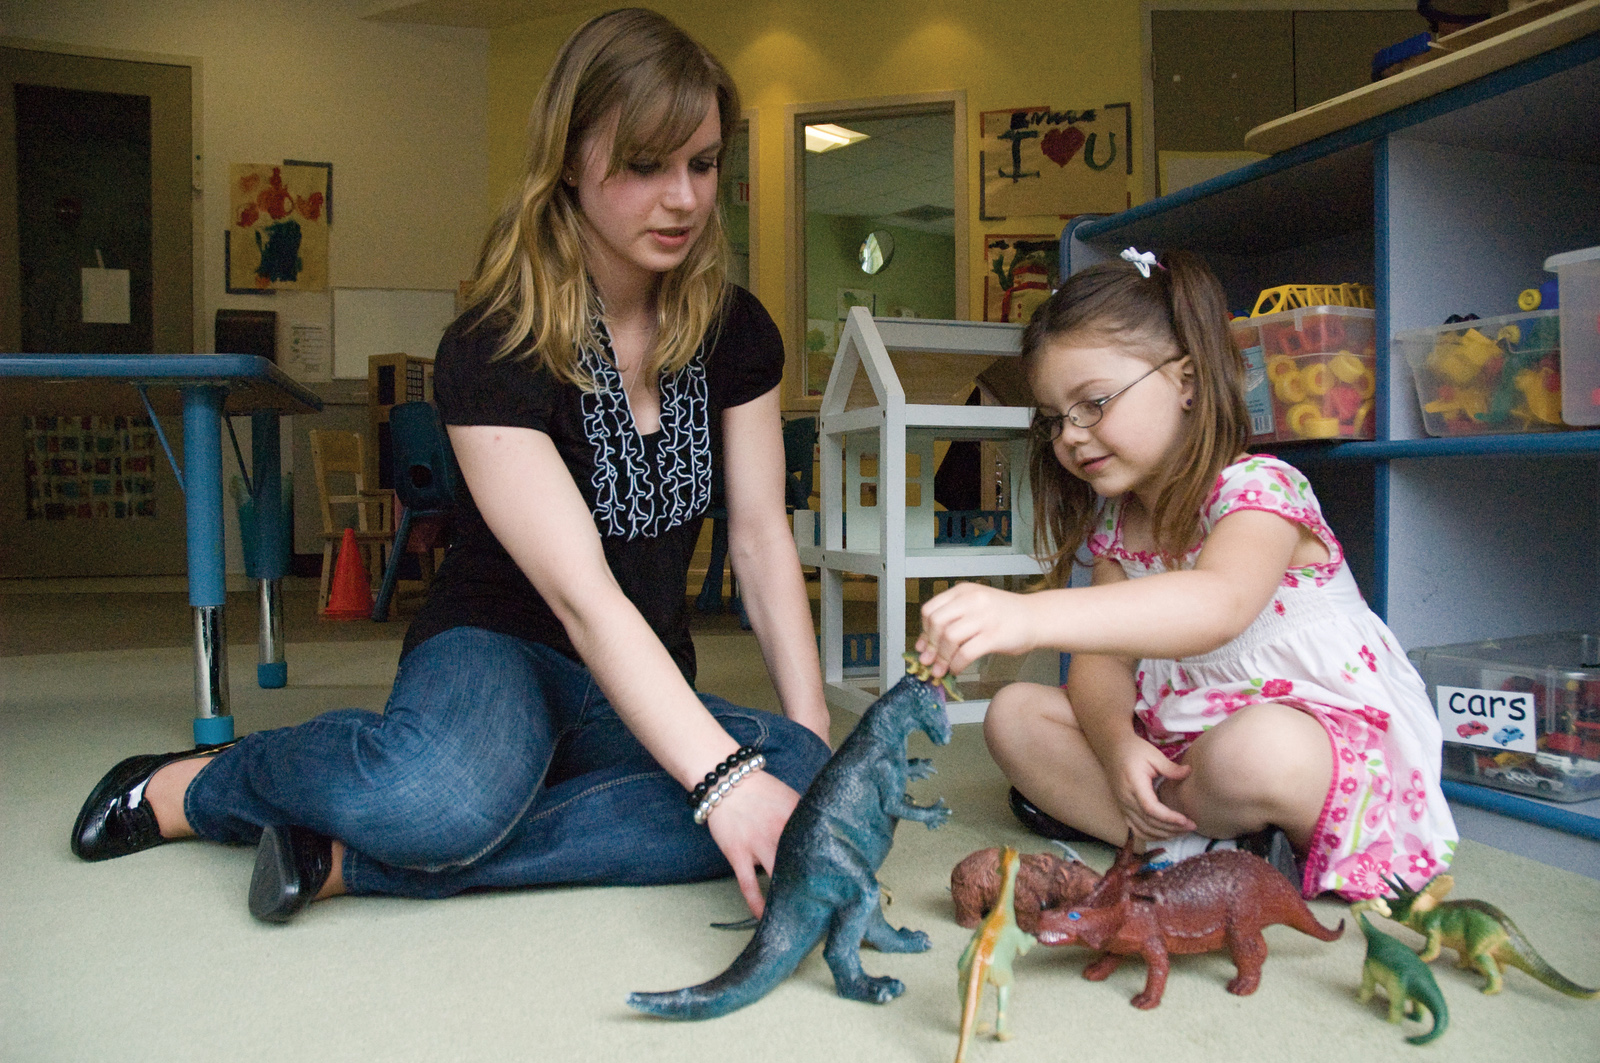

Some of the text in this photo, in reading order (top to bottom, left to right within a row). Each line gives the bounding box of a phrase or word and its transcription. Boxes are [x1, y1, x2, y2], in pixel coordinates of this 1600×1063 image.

[996, 130, 1117, 183] I U
[1448, 691, 1527, 721] cars
